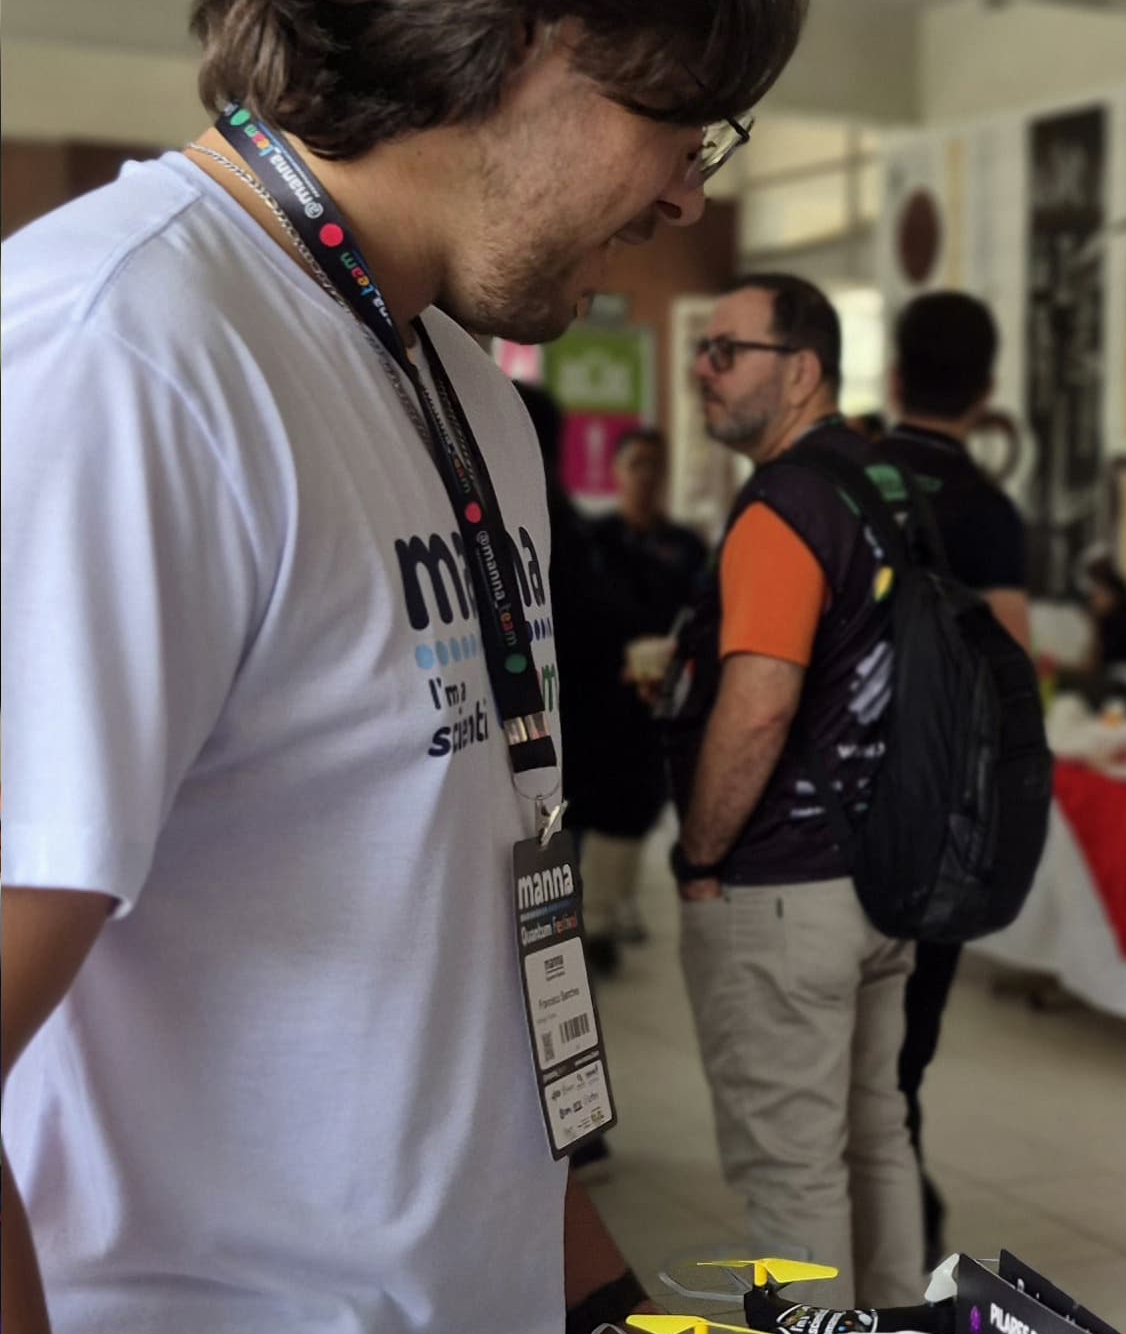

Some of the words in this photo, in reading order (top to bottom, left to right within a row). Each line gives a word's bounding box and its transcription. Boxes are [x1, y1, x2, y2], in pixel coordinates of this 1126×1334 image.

[242, 122, 325, 219] @manna_team
[474, 530, 520, 647] @manna_team
[518, 863, 575, 910] manna
